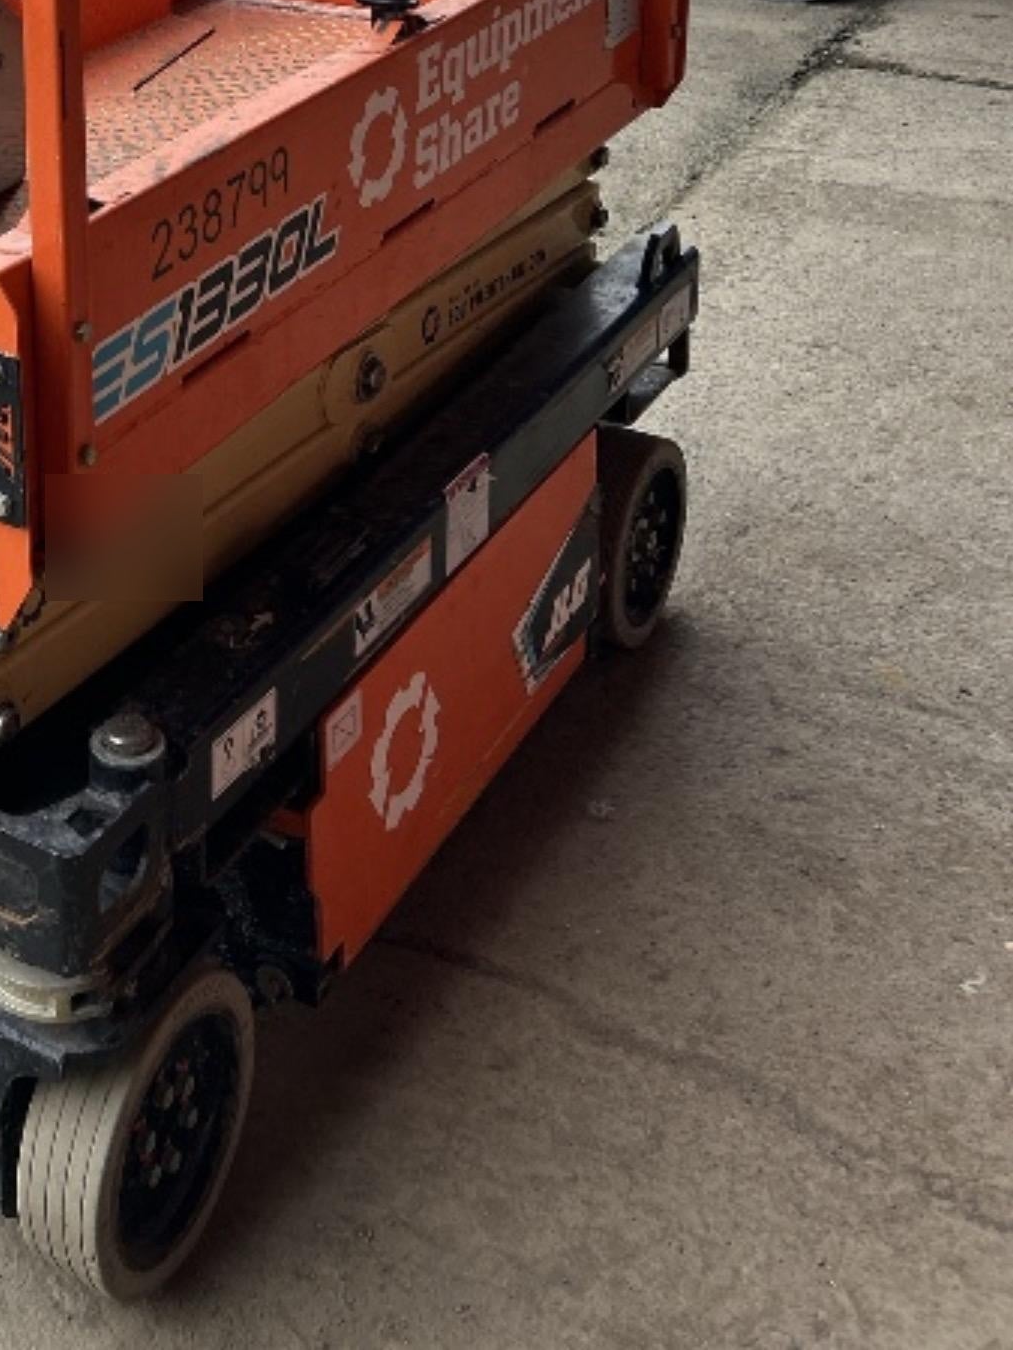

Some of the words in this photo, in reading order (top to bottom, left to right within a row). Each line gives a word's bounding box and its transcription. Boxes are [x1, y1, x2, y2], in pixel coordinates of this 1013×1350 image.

[412, 81, 520, 189] Share
[152, 146, 288, 281] 238799
[91, 191, 341, 426] ES1330L
